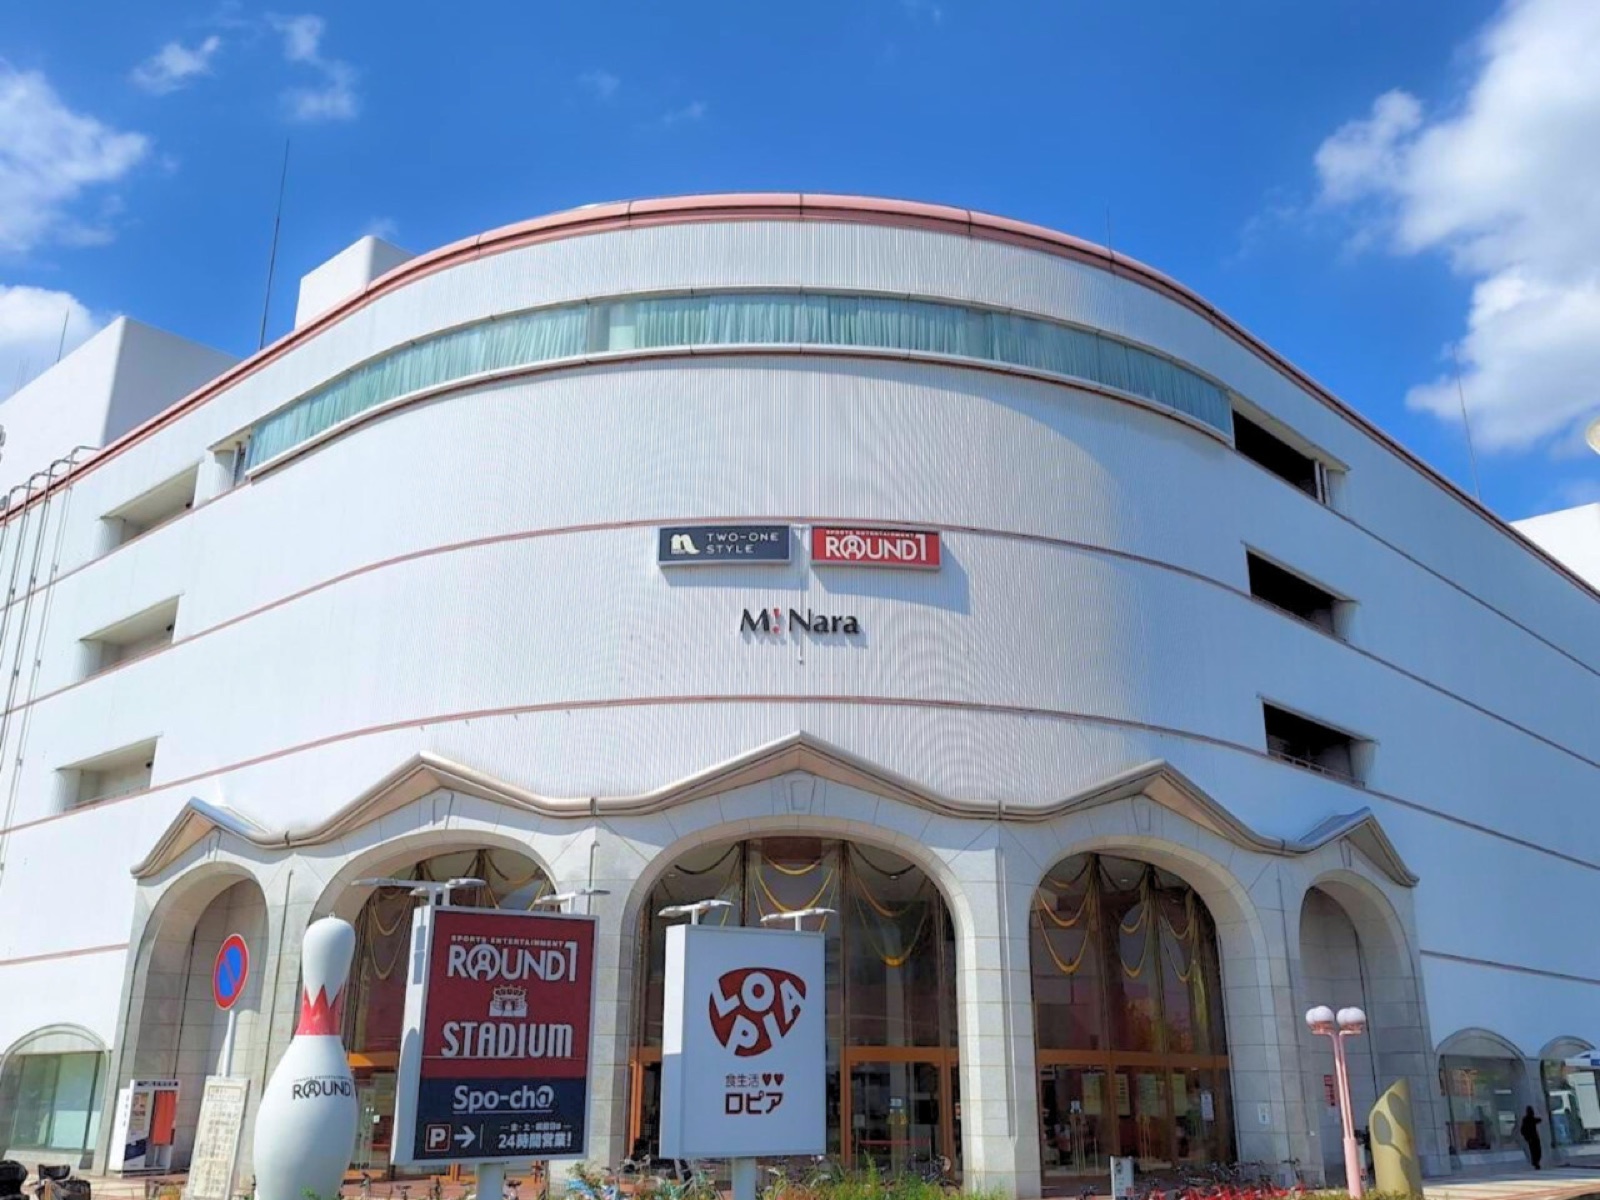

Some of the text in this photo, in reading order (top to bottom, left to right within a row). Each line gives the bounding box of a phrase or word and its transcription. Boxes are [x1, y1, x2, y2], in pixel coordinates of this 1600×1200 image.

[706, 532, 779, 542] TWO-ONE
[706, 544, 755, 554] STYLE
[825, 534, 927, 561] ROUND1
[789, 608, 860, 634] Nara
[447, 941, 577, 982] ROUND1
[441, 1021, 573, 1058] STADIUM
[725, 1090, 783, 1115] ロピア
[430, 1128, 446, 1148] P
